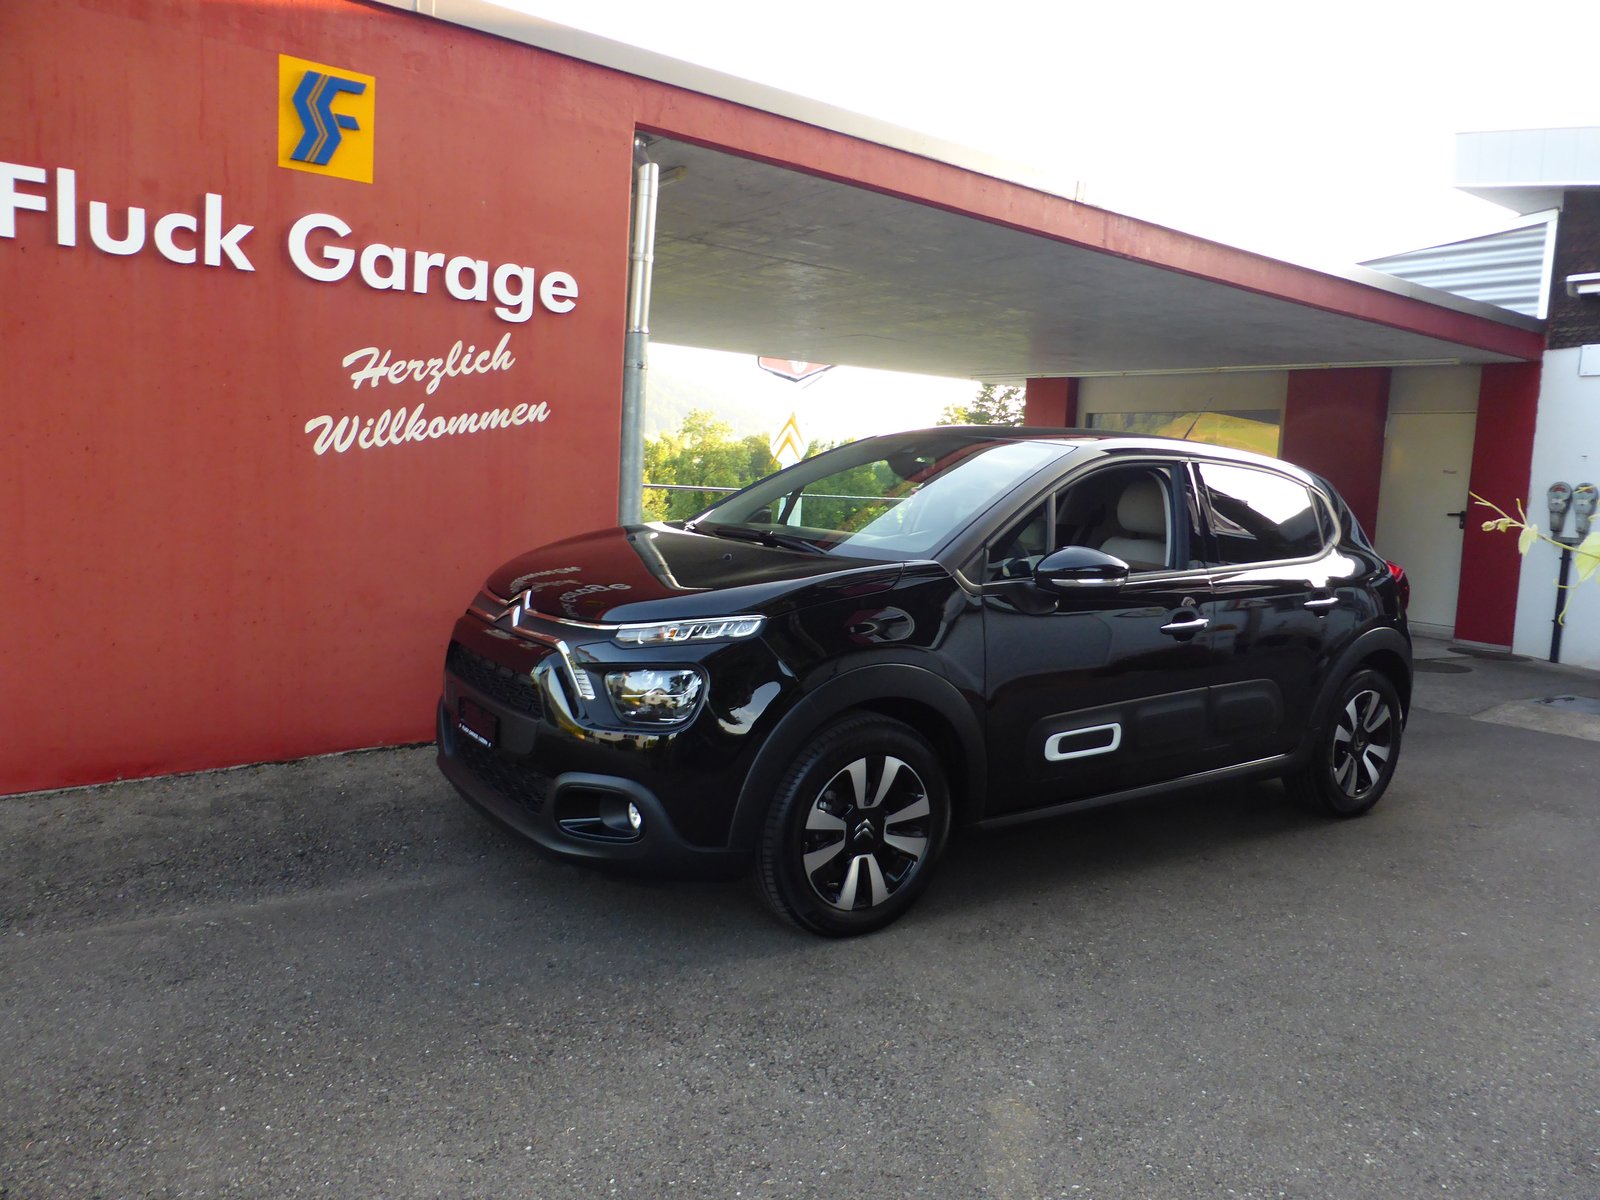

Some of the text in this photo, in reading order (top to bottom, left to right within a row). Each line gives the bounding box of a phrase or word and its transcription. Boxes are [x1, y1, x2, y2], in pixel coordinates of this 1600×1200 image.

[0, 161, 580, 323] Fluck Garage
[341, 332, 516, 395] Herzlich
[304, 400, 552, 456] Willkommen
